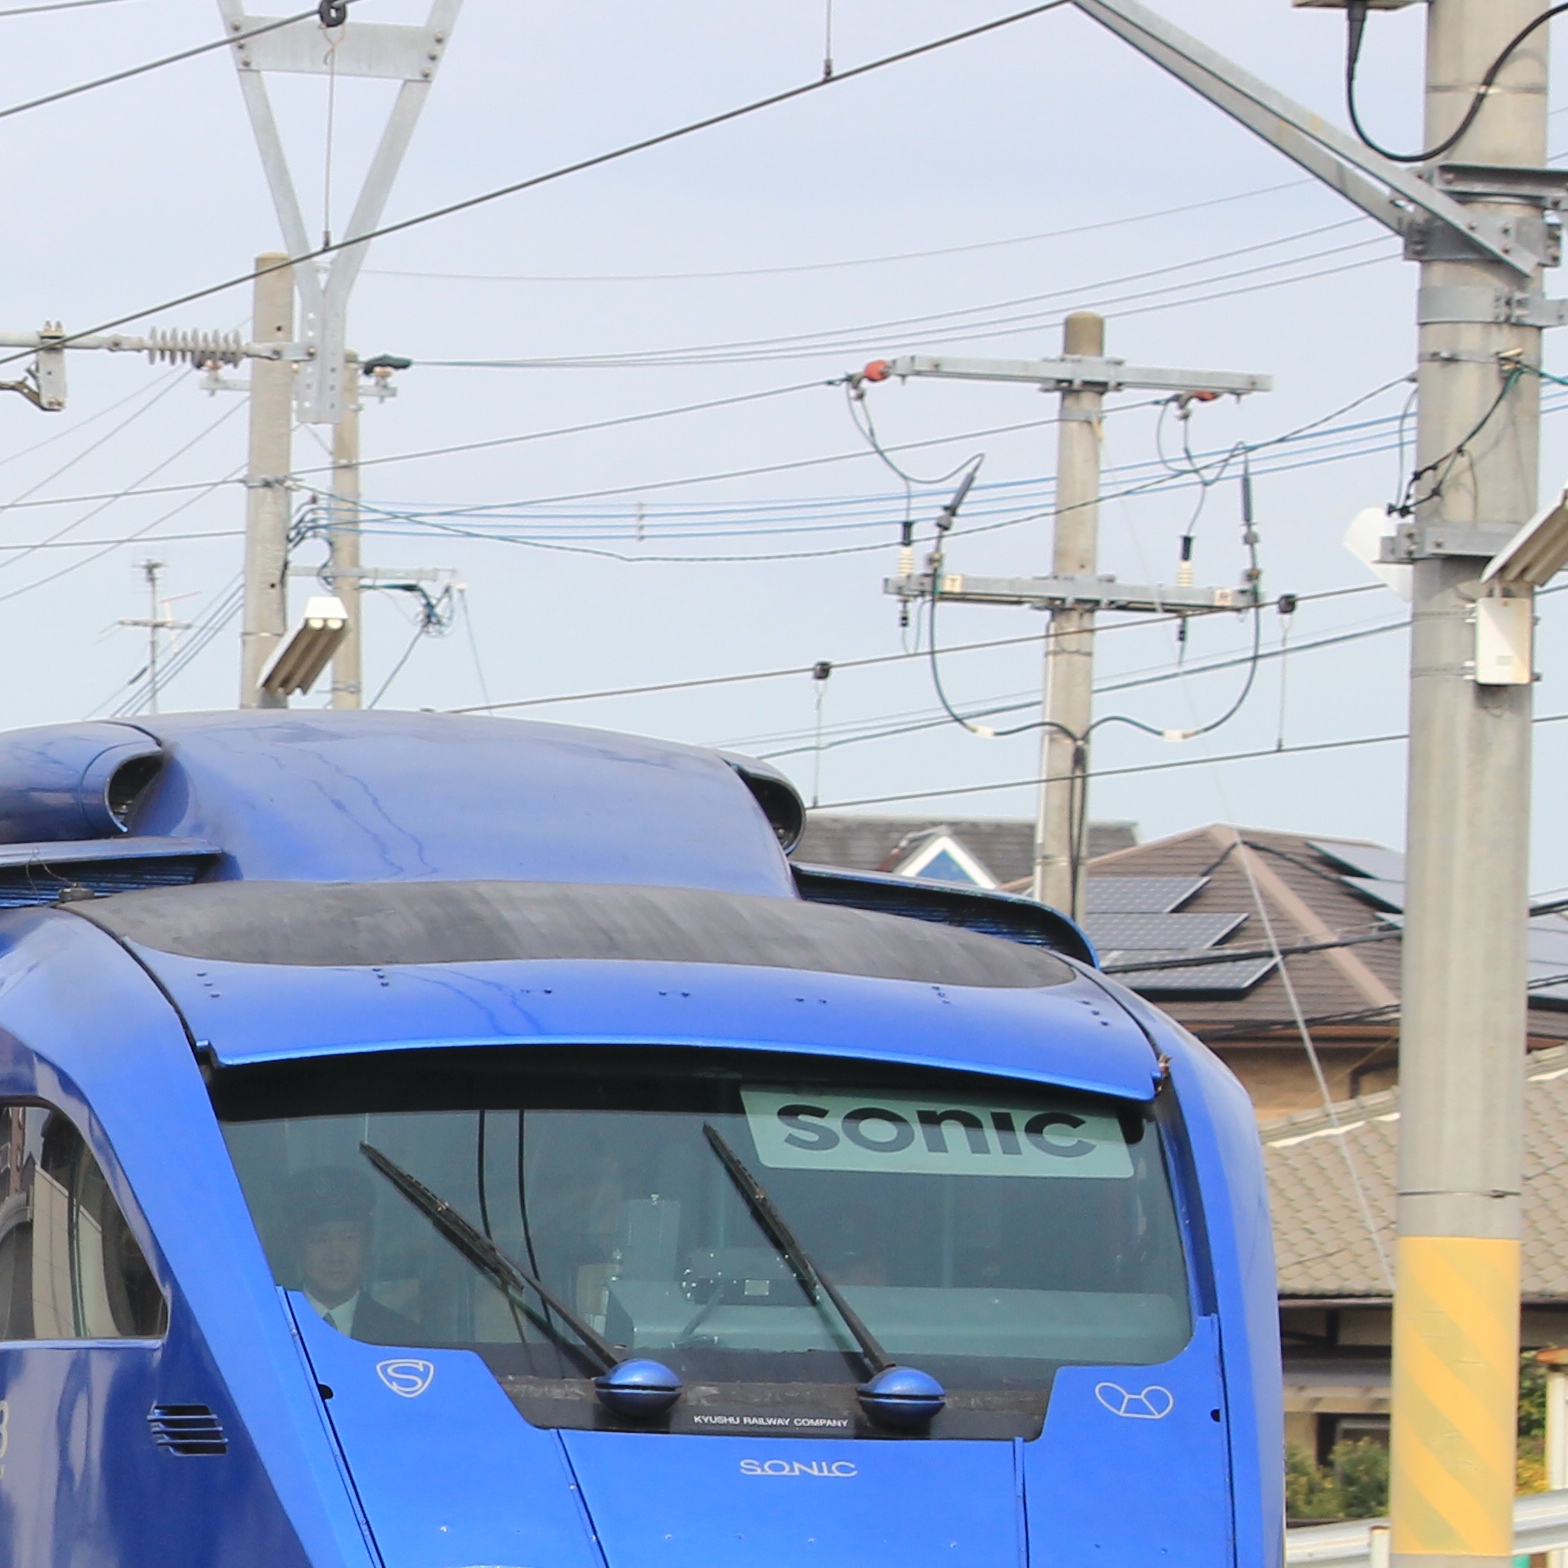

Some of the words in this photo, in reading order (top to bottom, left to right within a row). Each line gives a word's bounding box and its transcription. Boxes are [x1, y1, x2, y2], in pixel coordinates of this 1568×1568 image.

[693, 1415, 740, 1425] KYUSHU
[743, 1416, 790, 1426] RAILWAY
[793, 1417, 849, 1428] COMPANY
[739, 1459, 858, 1477] SONIC
